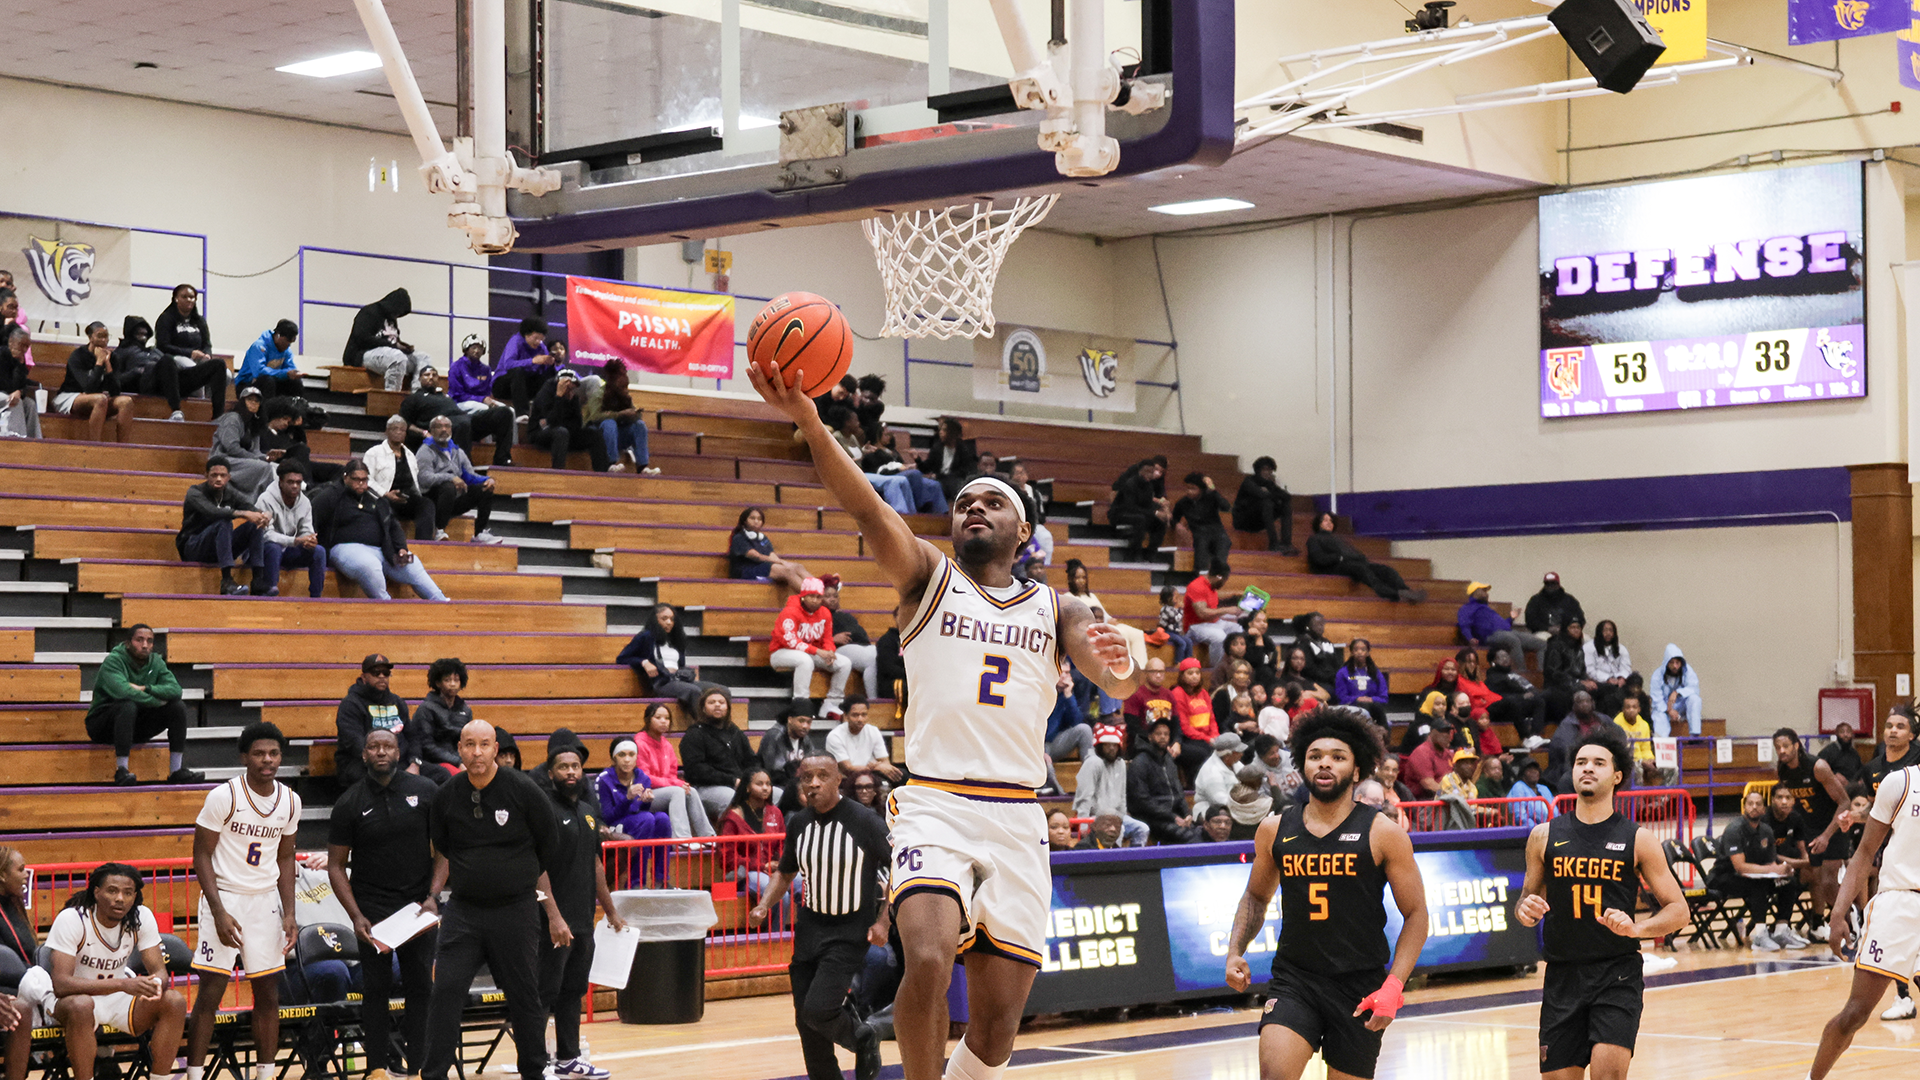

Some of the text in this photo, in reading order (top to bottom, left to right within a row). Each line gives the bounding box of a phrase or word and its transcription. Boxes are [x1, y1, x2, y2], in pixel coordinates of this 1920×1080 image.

[1555, 231, 1847, 296] DEFENSE
[618, 311, 691, 337] PRISMA
[1613, 352, 1648, 384] 53
[1755, 339, 1790, 373] 33
[940, 611, 1053, 656] BENEDICT
[977, 653, 1012, 708] 2
[230, 821, 284, 839] BENEDICT
[246, 841, 263, 867] 6
[1282, 853, 1358, 877] SKEGEE
[1553, 856, 1625, 881] SKEGEE
[1308, 882, 1329, 921] 5
[1571, 884, 1602, 919] 14
[1427, 905, 1508, 937] LLEGE
[201, 941, 214, 963] BC
[1869, 939, 1883, 963] BC
